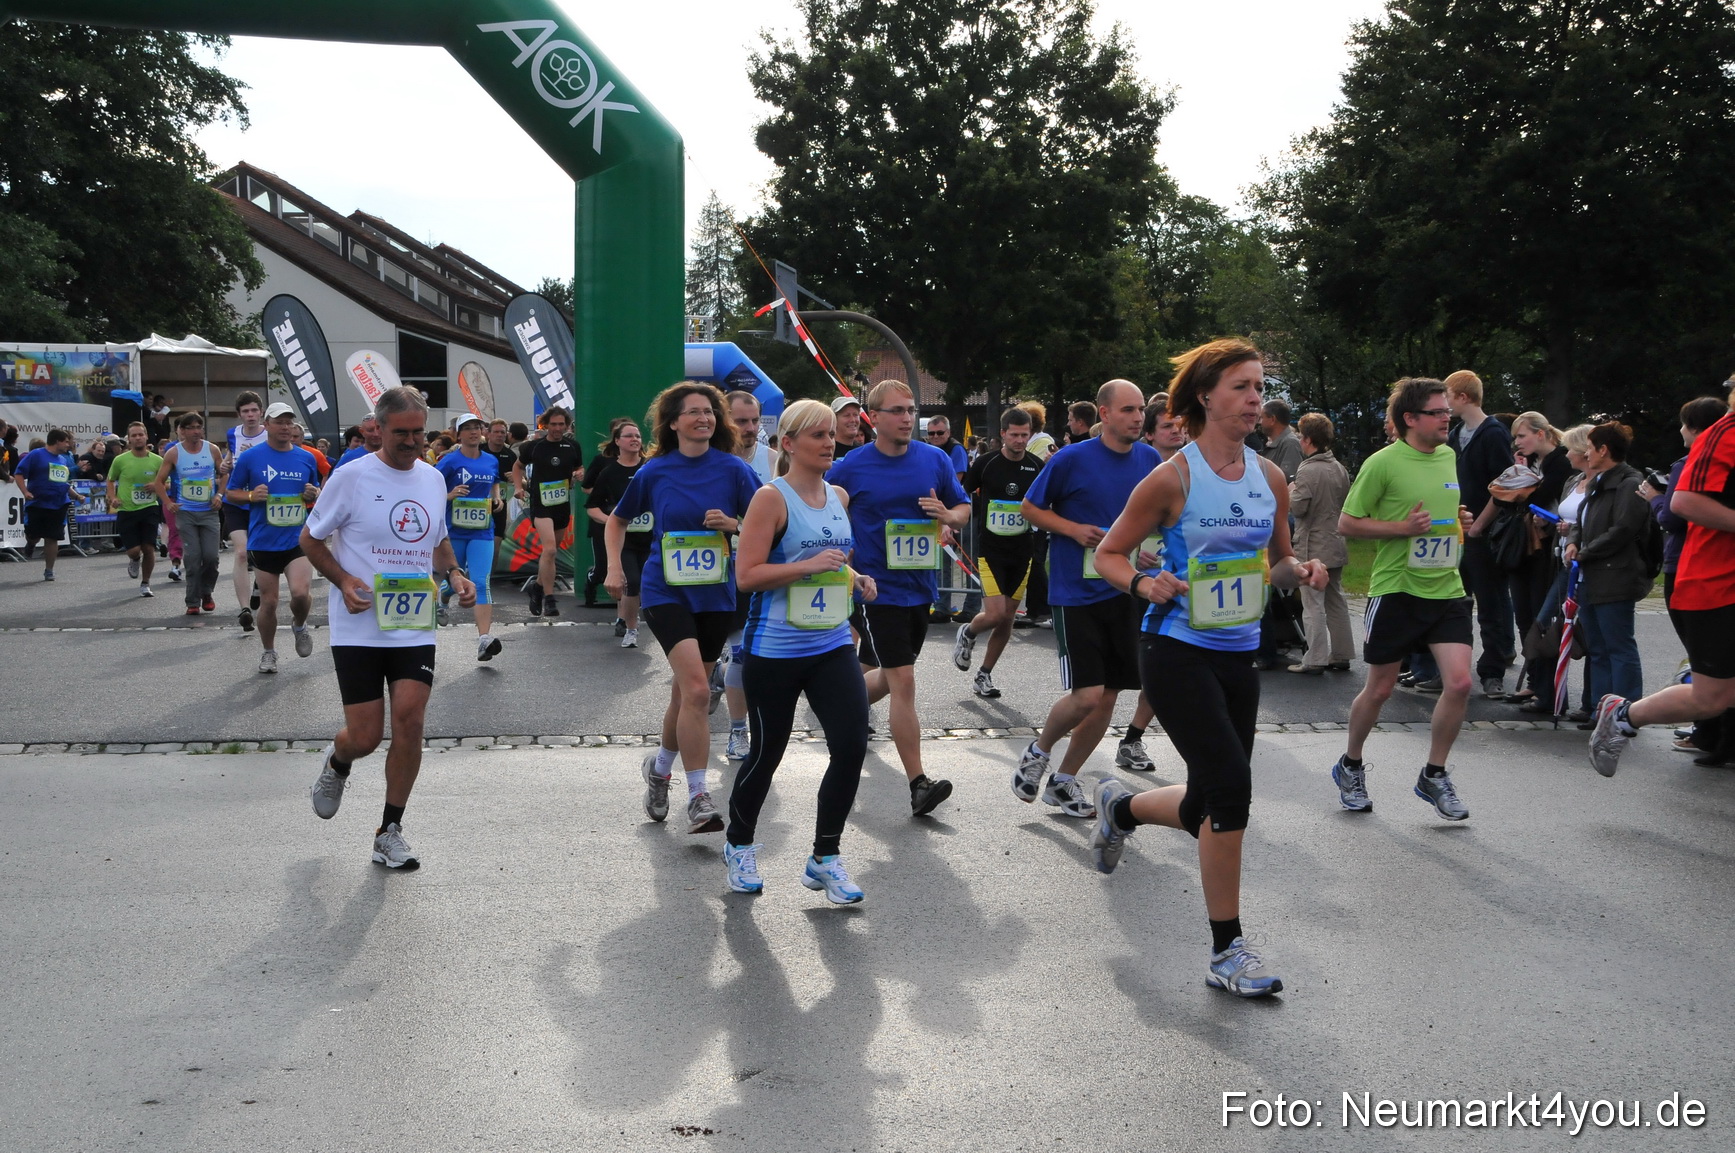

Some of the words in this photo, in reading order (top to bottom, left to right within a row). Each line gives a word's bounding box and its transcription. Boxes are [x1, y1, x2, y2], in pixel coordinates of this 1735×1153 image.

[476, 19, 641, 155] AOK
[1, 364, 51, 380] TLA
[58, 372, 117, 390] Logistics
[17, 422, 109, 434] www.tla-gmbh.de
[51, 469, 66, 478] 162
[133, 491, 152, 500] 382
[189, 486, 203, 496] 18
[541, 488, 566, 500] 1185
[269, 505, 302, 518] 1177
[454, 508, 486, 521] 1165
[989, 512, 1024, 527] 1183
[892, 536, 930, 557] 119
[1414, 537, 1451, 558] 371
[671, 549, 716, 571] 149
[810, 587, 827, 613] 4
[1210, 577, 1243, 609] 11
[381, 592, 428, 615] 787
[1211, 609, 1236, 618] Sandra
